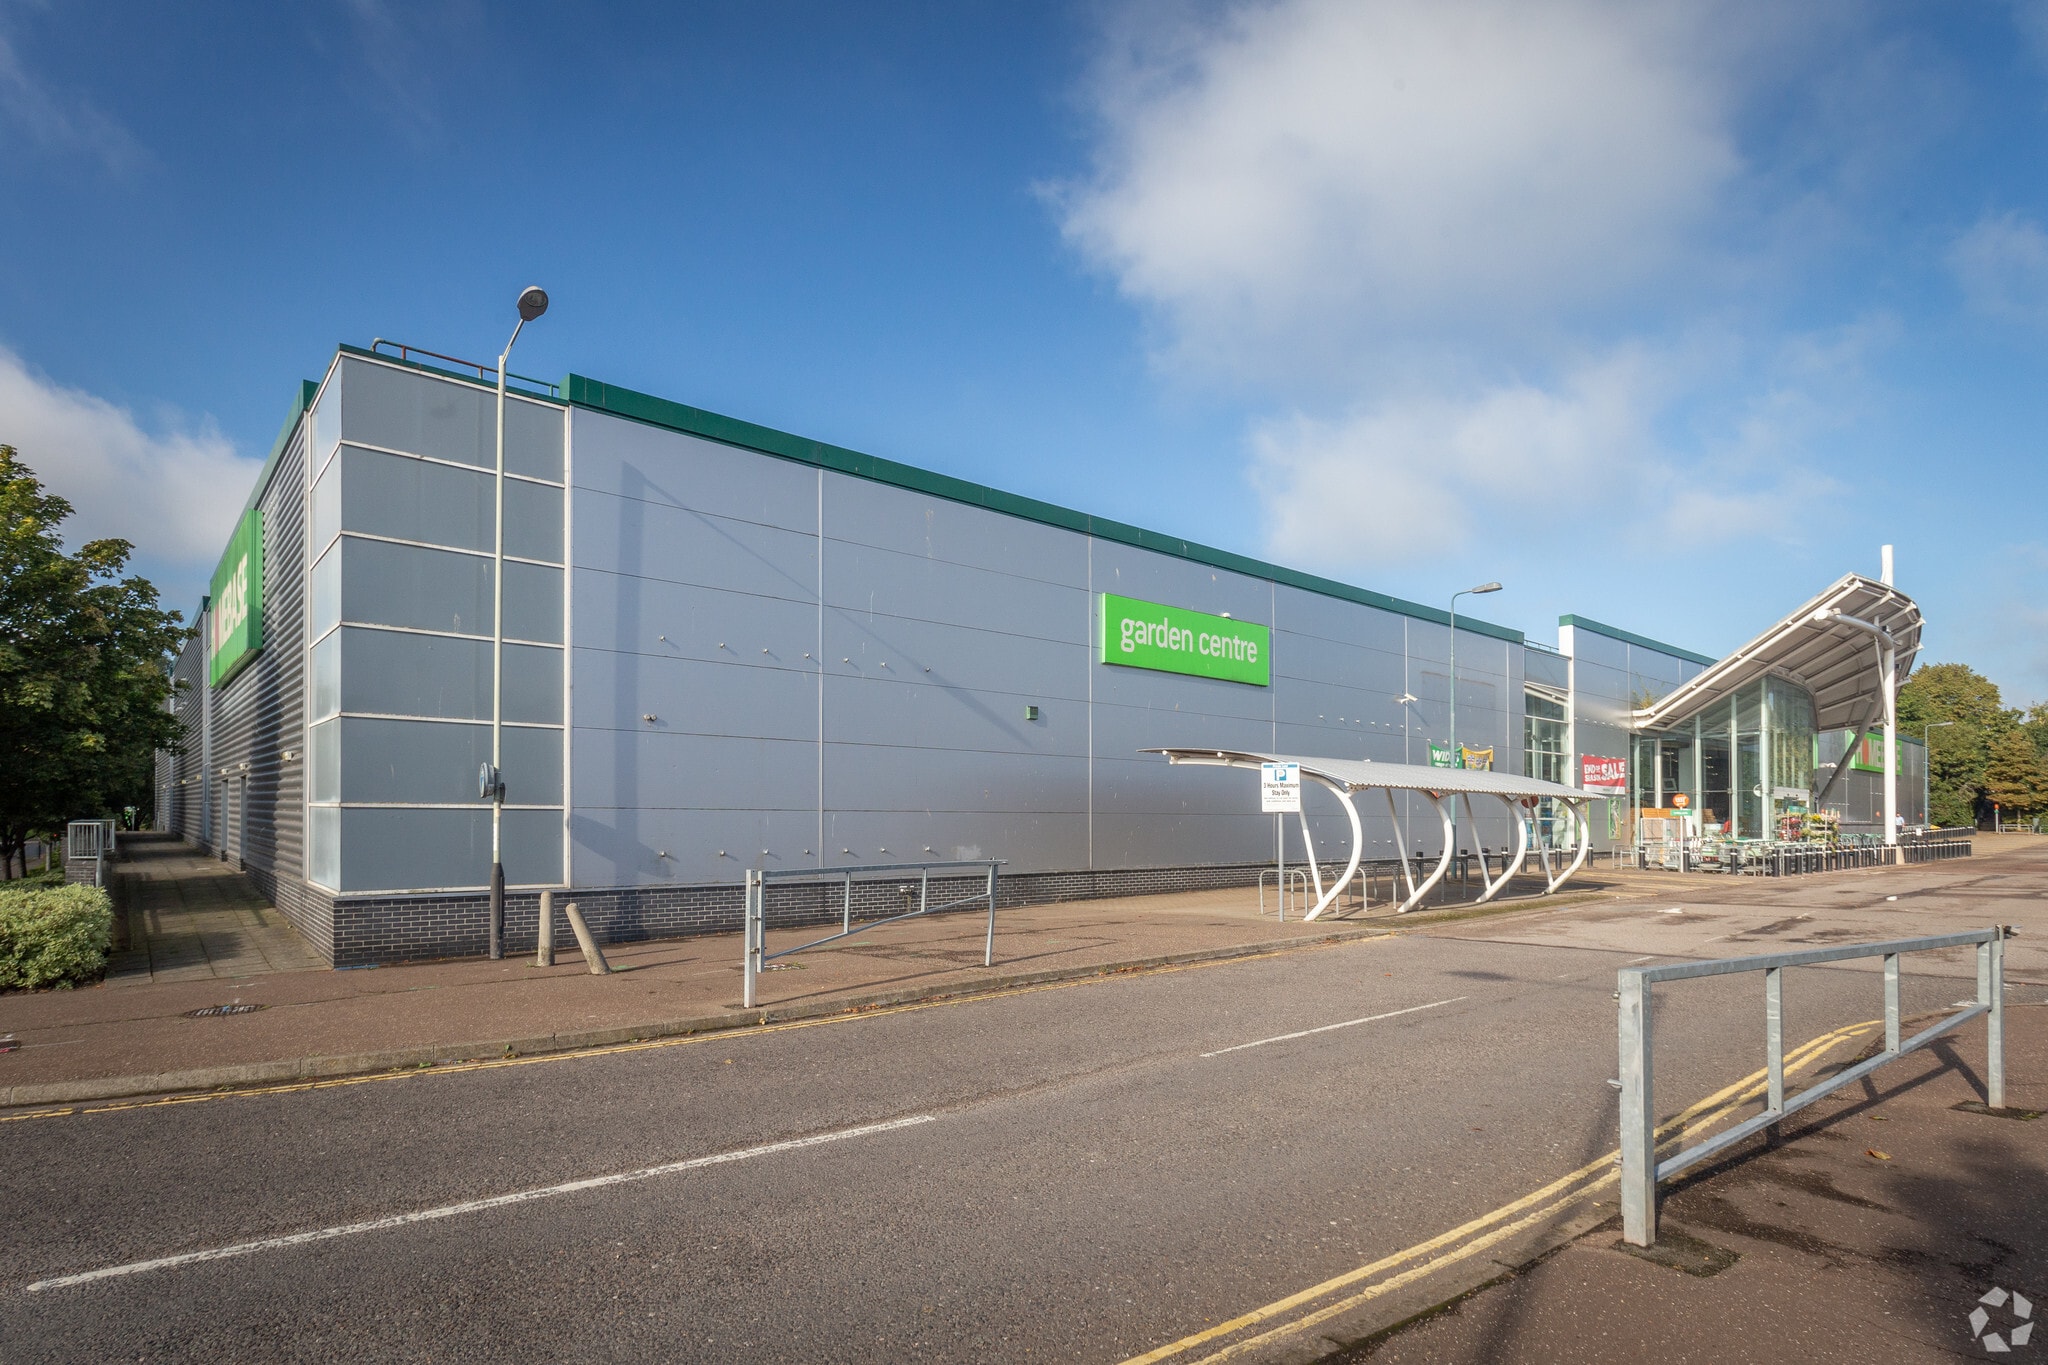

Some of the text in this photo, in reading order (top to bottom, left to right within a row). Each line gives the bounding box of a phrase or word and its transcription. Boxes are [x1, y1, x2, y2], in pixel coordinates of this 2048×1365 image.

[1120, 617, 1257, 663] garden centre
[1601, 761, 1625, 782] SALE
